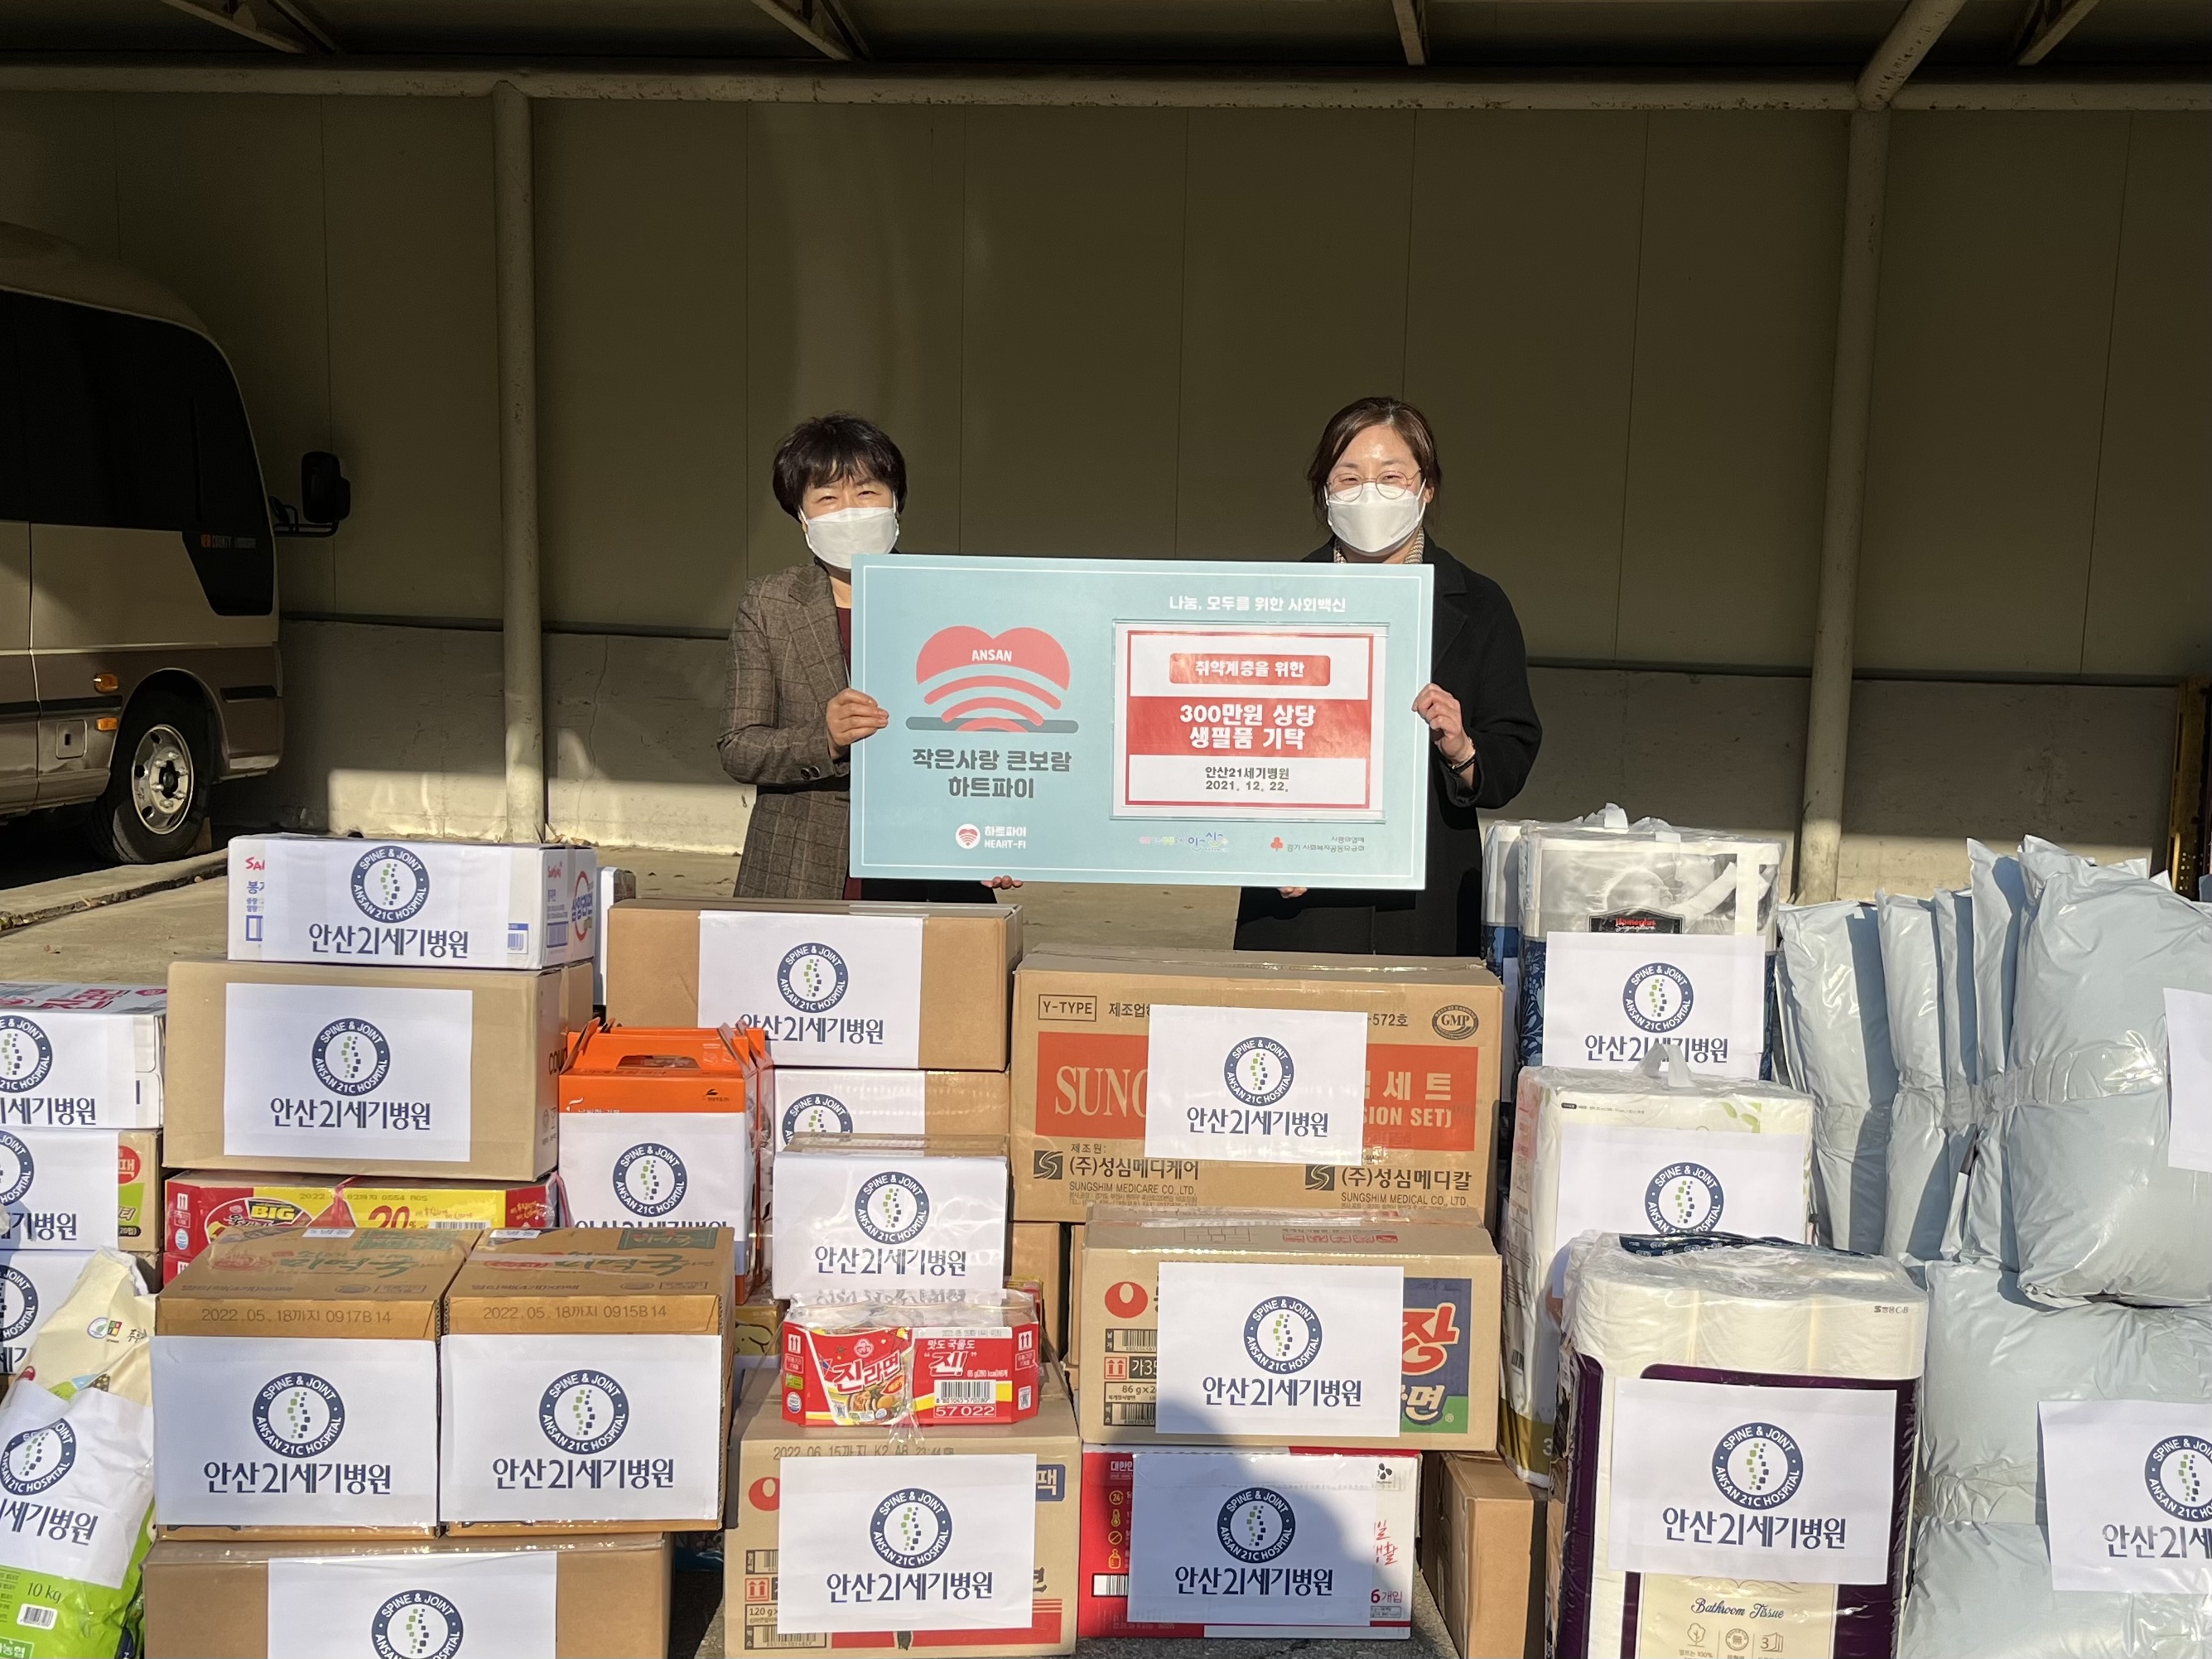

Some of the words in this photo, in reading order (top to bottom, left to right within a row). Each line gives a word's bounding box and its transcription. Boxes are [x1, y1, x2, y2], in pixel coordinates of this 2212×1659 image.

[1169, 596, 1202, 611] 나눔,
[1207, 596, 1250, 611] 모두를
[1255, 596, 1284, 612] 위한
[1288, 597, 1346, 613] 사회백신
[971, 649, 1013, 663] ANSAN
[1195, 660, 1269, 678] 취약계층을
[1275, 661, 1304, 678] 위한
[1179, 704, 1263, 726] 300만원
[1273, 705, 1316, 727] 상당
[1189, 726, 1254, 749] 생필품
[1263, 728, 1305, 750] 기탁
[913, 748, 999, 770] 작은사랑
[1007, 750, 1072, 772] 큰보람
[1205, 767, 1290, 780] 안산21세기병원
[948, 776, 1034, 798] 하트파이
[1205, 780, 1240, 791] 2021.
[1246, 781, 1264, 792] 12.
[1269, 781, 1289, 792] 22.
[985, 826, 1027, 837] 하트파이
[984, 839, 1027, 849] HEART-FI
[359, 849, 386, 872] SPINE
[388, 848, 394, 857] &
[396, 850, 422, 870] JOINT
[354, 887, 376, 917] ANSAN
[375, 913, 394, 921] 21C
[396, 885, 426, 920] HOSPITAL
[309, 923, 469, 959] 안산21세기병원
[1043, 1001, 1093, 1015] Y-TYPE
[8, 1017, 15, 1028] &
[17, 1020, 44, 1041] JOINT
[320, 1021, 347, 1044] SPINE
[349, 1020, 355, 1030] &
[357, 1022, 383, 1043] JOINT
[1441, 1014, 1469, 1027] GMP
[1585, 1035, 1728, 1063] 안산21기병원
[21, 1055, 51, 1090] HOSPITAL
[315, 1059, 336, 1089] ANSAN
[336, 1085, 354, 1093] 21C
[356, 1058, 387, 1092] HOSPITAL
[270, 1097, 431, 1131] 안산21세기병원
[1187, 1107, 1328, 1138] 안산21세기병원
[1069, 1158, 1199, 1180] (주)성심메디케어
[1342, 1167, 1472, 1191] (주)성심메디칼
[1069, 1181, 1113, 1191] SUNGSHIM
[1116, 1184, 1159, 1194] MEDICARE
[1341, 1192, 1386, 1203] SUNGSHIM
[1390, 1194, 1428, 1205] MEDICAL
[250, 1205, 295, 1222] BIG
[2, 1212, 77, 1241] 기병원
[815, 1246, 966, 1277] 안산21세기병원
[927, 1339, 946, 1350] 맛도
[947, 1339, 976, 1350] 국물도
[831, 1348, 901, 1395] 진라면
[263, 1377, 294, 1401] SPINE
[296, 1375, 304, 1385] &
[306, 1377, 337, 1400] JOINT
[1121, 1385, 1134, 1394] 86
[1202, 1377, 1361, 1407] 안산21세기병원
[55, 1422, 73, 1444] OINT
[256, 1418, 282, 1450] ANSAN
[282, 1446, 303, 1455] 21C
[306, 1416, 342, 1454] HOSPITAL
[1722, 1426, 1753, 1452] SPINE
[1755, 1425, 1762, 1435] &
[1765, 1427, 1795, 1450] JOINT
[2153, 1439, 2181, 1462] SPINE
[2183, 1438, 2191, 1448] &
[2193, 1440, 2212, 1460] JOIN
[2, 1450, 12, 1484] ANSAN
[8, 1479, 26, 1493] 21C
[26, 1462, 70, 1493] HOSPITAL
[204, 1461, 391, 1496] 안산21세기병원
[493, 1458, 675, 1491] 안산21세기병원
[1715, 1469, 1741, 1502] ANSAN
[1740, 1497, 1762, 1507] 21C
[1764, 1468, 1800, 1507] HOSPITAL
[2149, 1478, 2177, 1512] ANSAN
[2178, 1507, 2199, 1519] 21C
[879, 1493, 907, 1516] SPINE
[908, 1492, 915, 1501] &
[918, 1493, 945, 1514] JOINT
[1663, 1507, 1846, 1551] 안산21세기병원
[873, 1531, 896, 1561] ANSAN
[895, 1556, 915, 1565] 21C
[917, 1529, 949, 1565] HOSPITAL
[2102, 1524, 2212, 1560] 안산21세
[27, 1582, 43, 1598] 10
[45, 1584, 62, 1604] kg
[826, 1571, 993, 1604] 안산21세기병원
[1175, 1565, 1333, 1597] 안산21세기병원
[749, 1607, 765, 1616] 120
[1691, 1597, 1746, 1616] Bathroom
[1749, 1603, 1784, 1619] Tissue
[0, 1642, 26, 1659] 농협
[1760, 1637, 1769, 1650] 3
